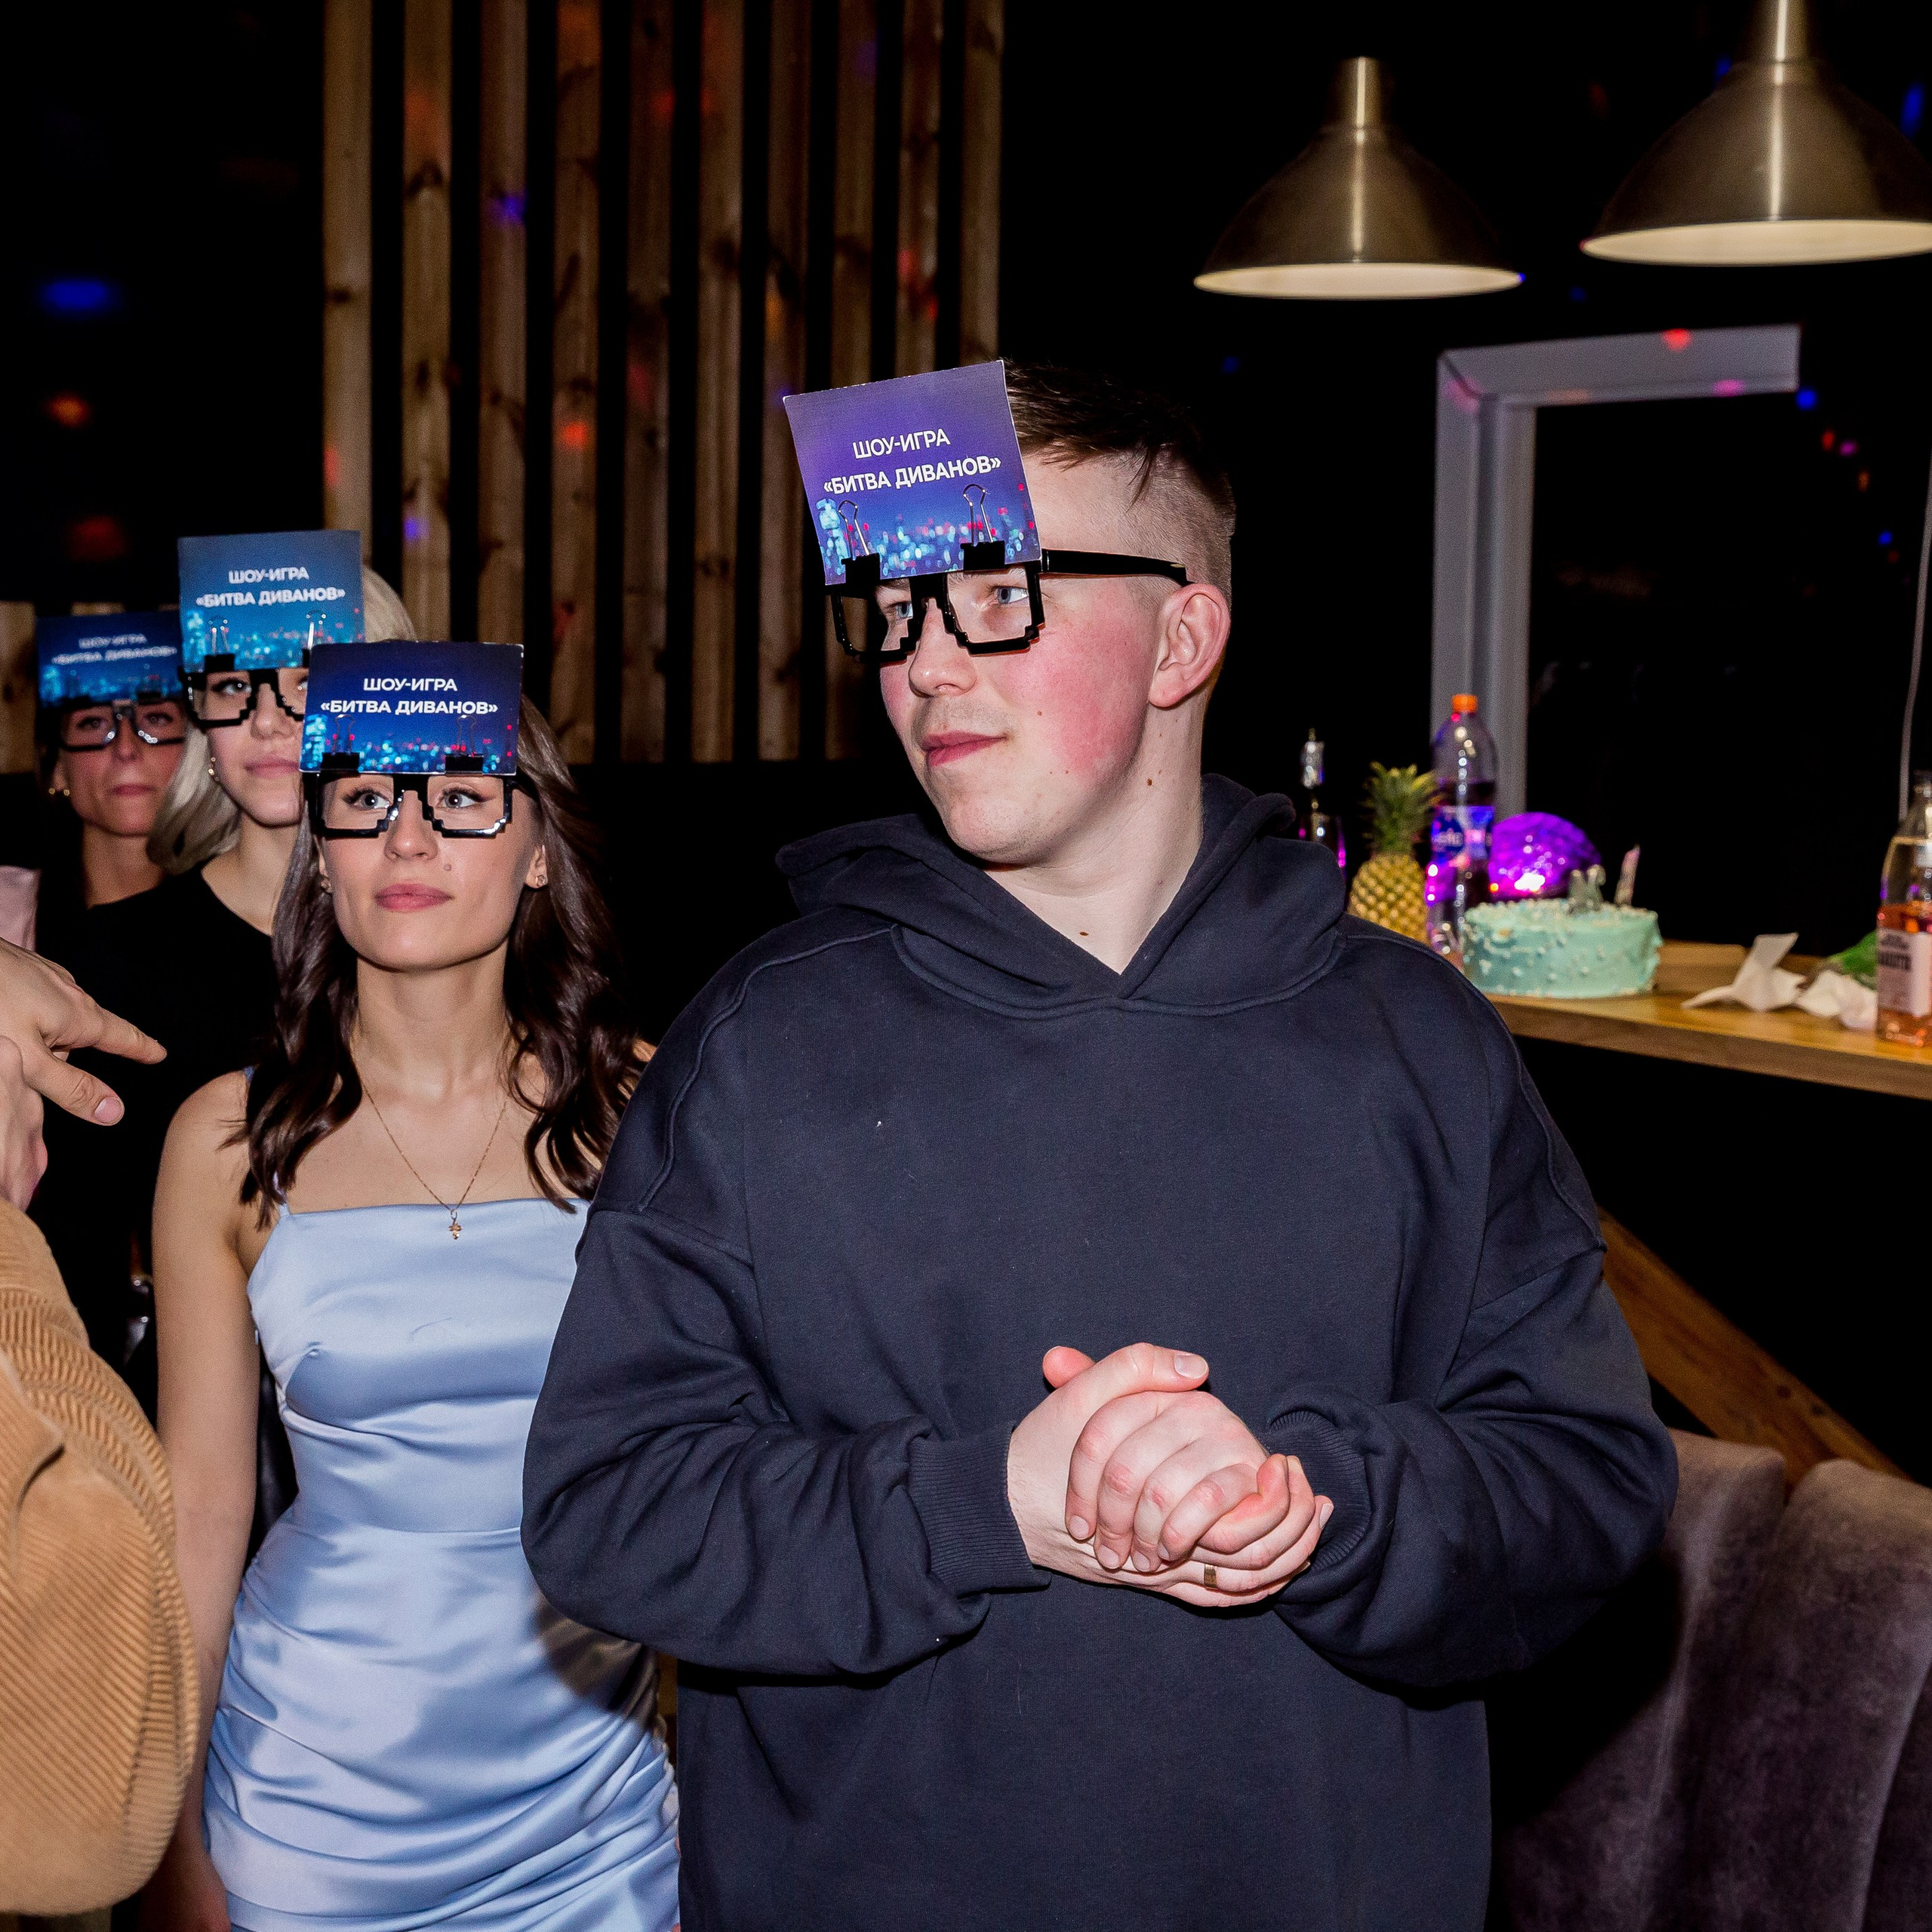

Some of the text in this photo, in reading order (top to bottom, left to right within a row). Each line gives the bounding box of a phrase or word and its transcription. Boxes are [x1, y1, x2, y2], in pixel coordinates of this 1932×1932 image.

[852, 429, 951, 459] ШОУ-ИГРА
[823, 455, 1001, 494] «БИТВА ДИВАНОВ»
[229, 567, 309, 584] ШОУ-ИГРА
[196, 587, 346, 608] «БИТВА ДИВАНОВ»
[363, 678, 458, 691] ШОУ-ИГРА
[320, 700, 499, 715] «БИТВА ДИВАНОВ»
